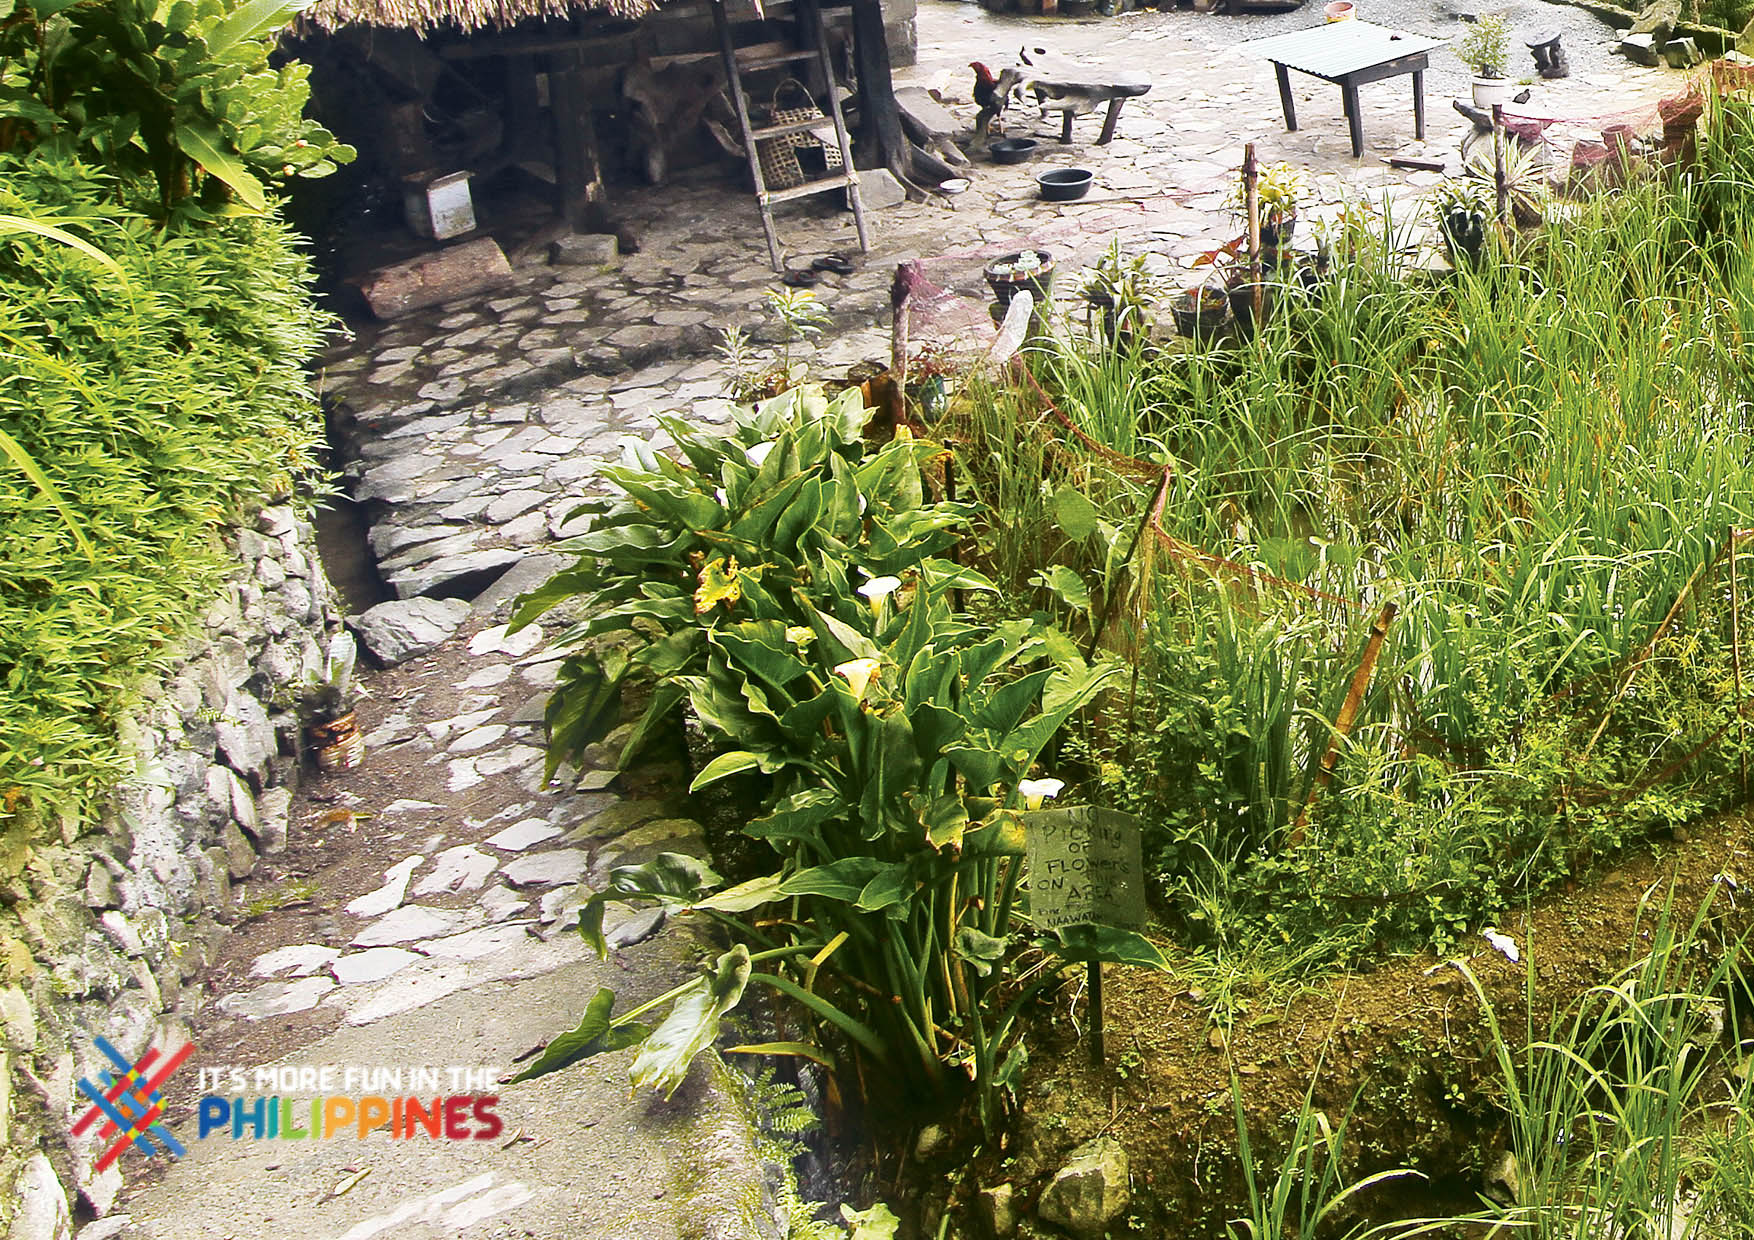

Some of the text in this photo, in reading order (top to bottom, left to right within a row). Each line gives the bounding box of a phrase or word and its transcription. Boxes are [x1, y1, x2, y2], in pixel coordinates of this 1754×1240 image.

[1067, 806, 1099, 824] NO
[1068, 840, 1093, 855] OF
[1037, 876, 1064, 890] ON
